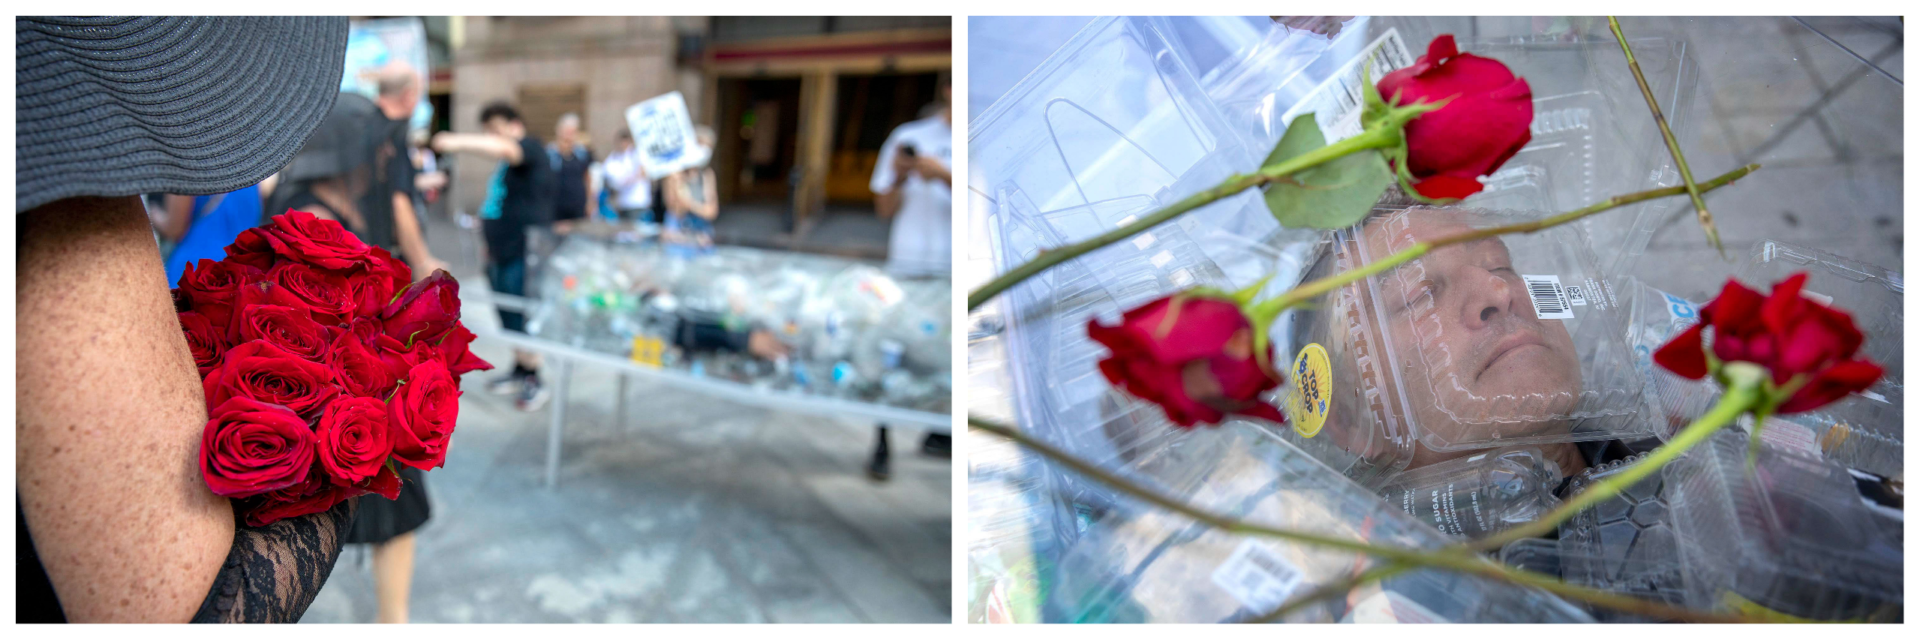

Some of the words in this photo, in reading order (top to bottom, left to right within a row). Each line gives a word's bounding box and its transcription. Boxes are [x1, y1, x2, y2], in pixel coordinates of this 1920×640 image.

[1301, 373, 1313, 414] CROP
[1308, 368, 1319, 400] TOP
[1431, 489, 1441, 523] SUGAR
[1442, 492, 1451, 525] VITAMINS
[1448, 483, 1462, 532] ANTIOXIDANTS
[1449, 524, 1457, 536] ITH
